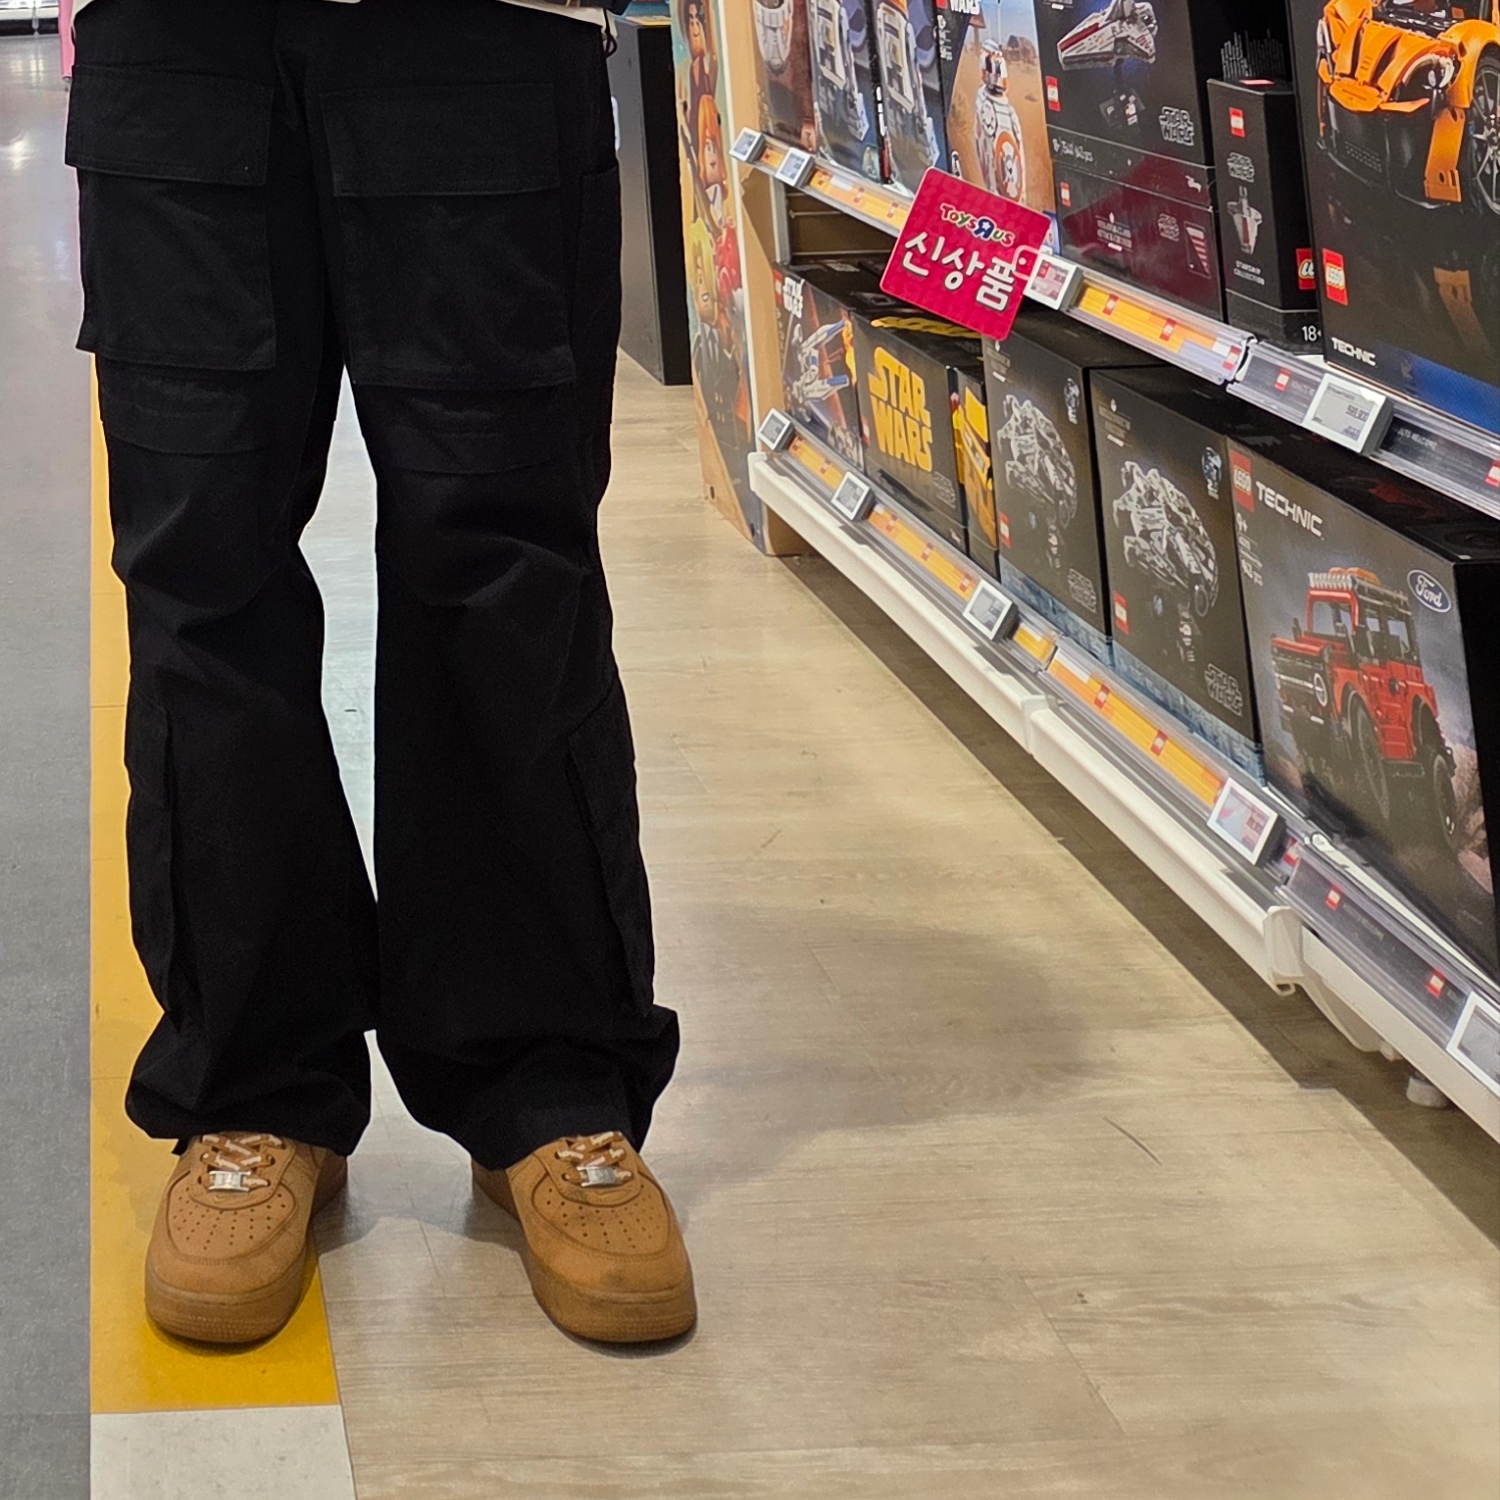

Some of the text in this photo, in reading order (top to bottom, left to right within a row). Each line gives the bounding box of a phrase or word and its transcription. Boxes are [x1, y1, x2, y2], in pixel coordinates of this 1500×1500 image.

[902, 232, 1015, 312] 신상품
[1331, 337, 1378, 366] TECHNIC
[868, 347, 931, 428] STAR
[869, 395, 933, 472] WARS
[1234, 467, 1251, 495] LEGO
[1255, 481, 1324, 537] TECHNIC
[1415, 574, 1443, 608] Ford
